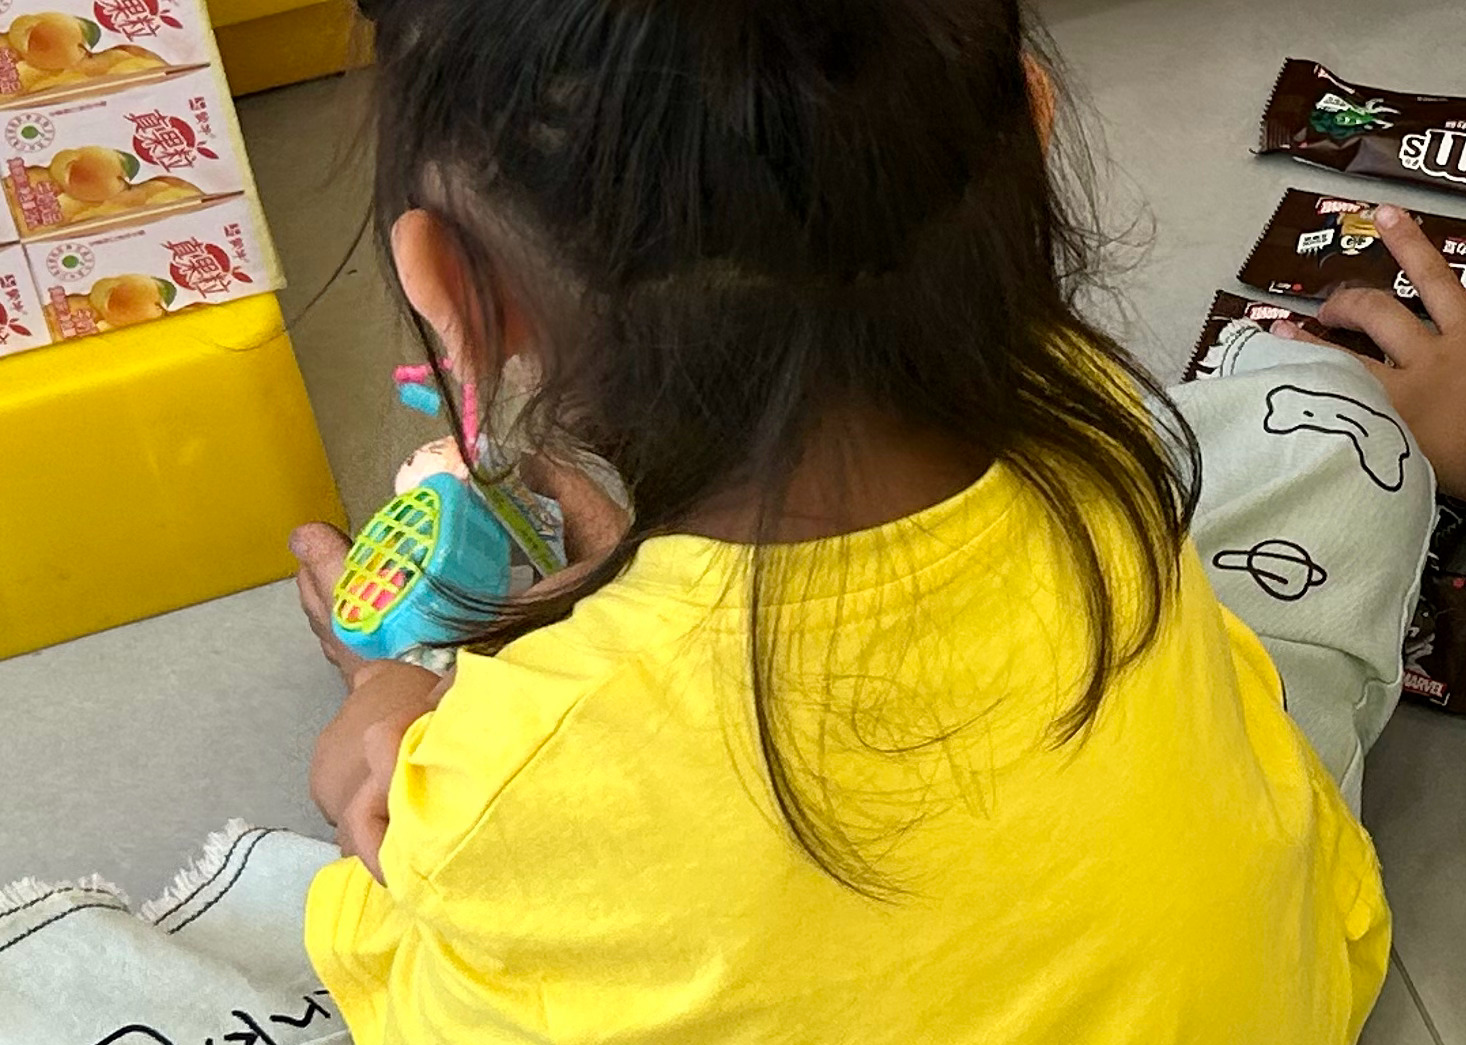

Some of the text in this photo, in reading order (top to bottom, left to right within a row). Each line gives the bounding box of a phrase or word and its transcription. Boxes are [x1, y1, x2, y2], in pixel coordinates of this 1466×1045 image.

[124, 109, 199, 173] 真果粒
[160, 237, 231, 299] 真果粒
